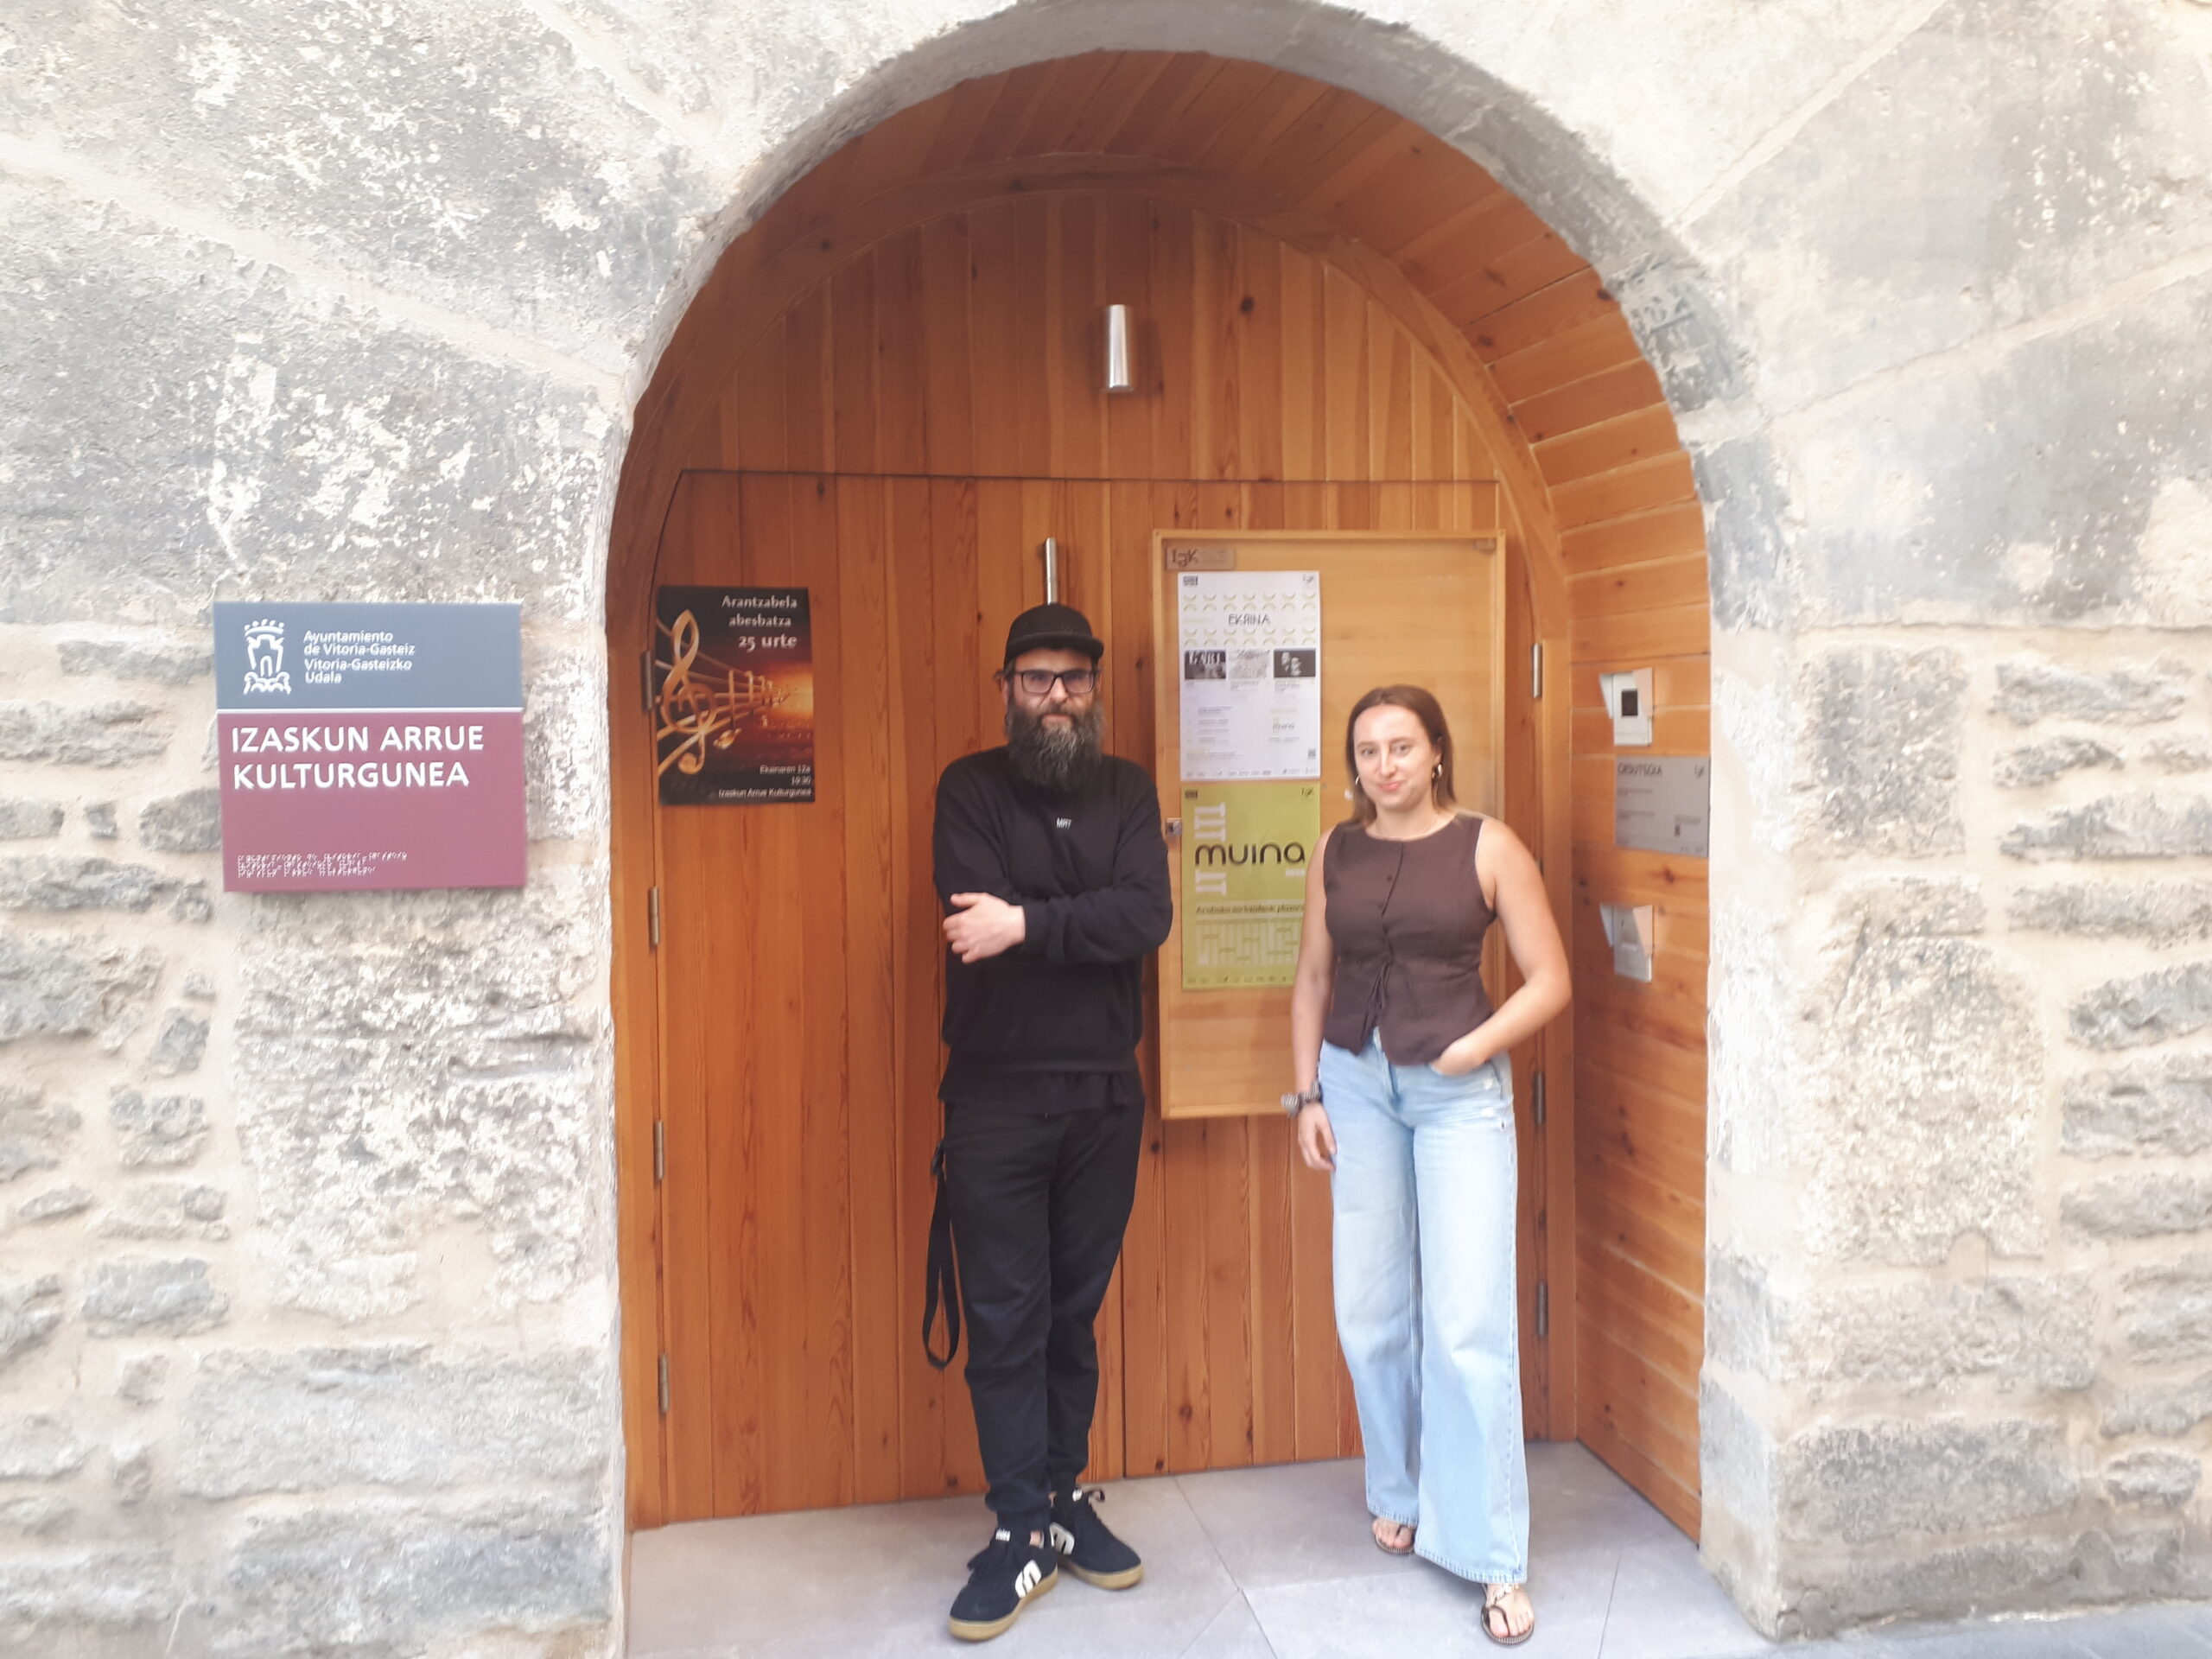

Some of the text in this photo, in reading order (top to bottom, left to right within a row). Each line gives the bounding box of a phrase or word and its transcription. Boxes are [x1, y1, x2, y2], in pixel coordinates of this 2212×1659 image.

[721, 594, 798, 608] Arantzabela
[728, 613, 791, 627] abesbatza
[303, 630, 394, 645] Ayuntamiento
[738, 632, 798, 653] 25 urte
[304, 643, 416, 656] de Vitoria-Gasteiz
[304, 658, 413, 671] Vitoria-Gasteizko
[305, 671, 342, 683] Udala
[232, 725, 484, 752] IZASKUN ARRUE
[233, 761, 470, 790] KULTURGUNEA
[1194, 842, 1306, 867] muina
